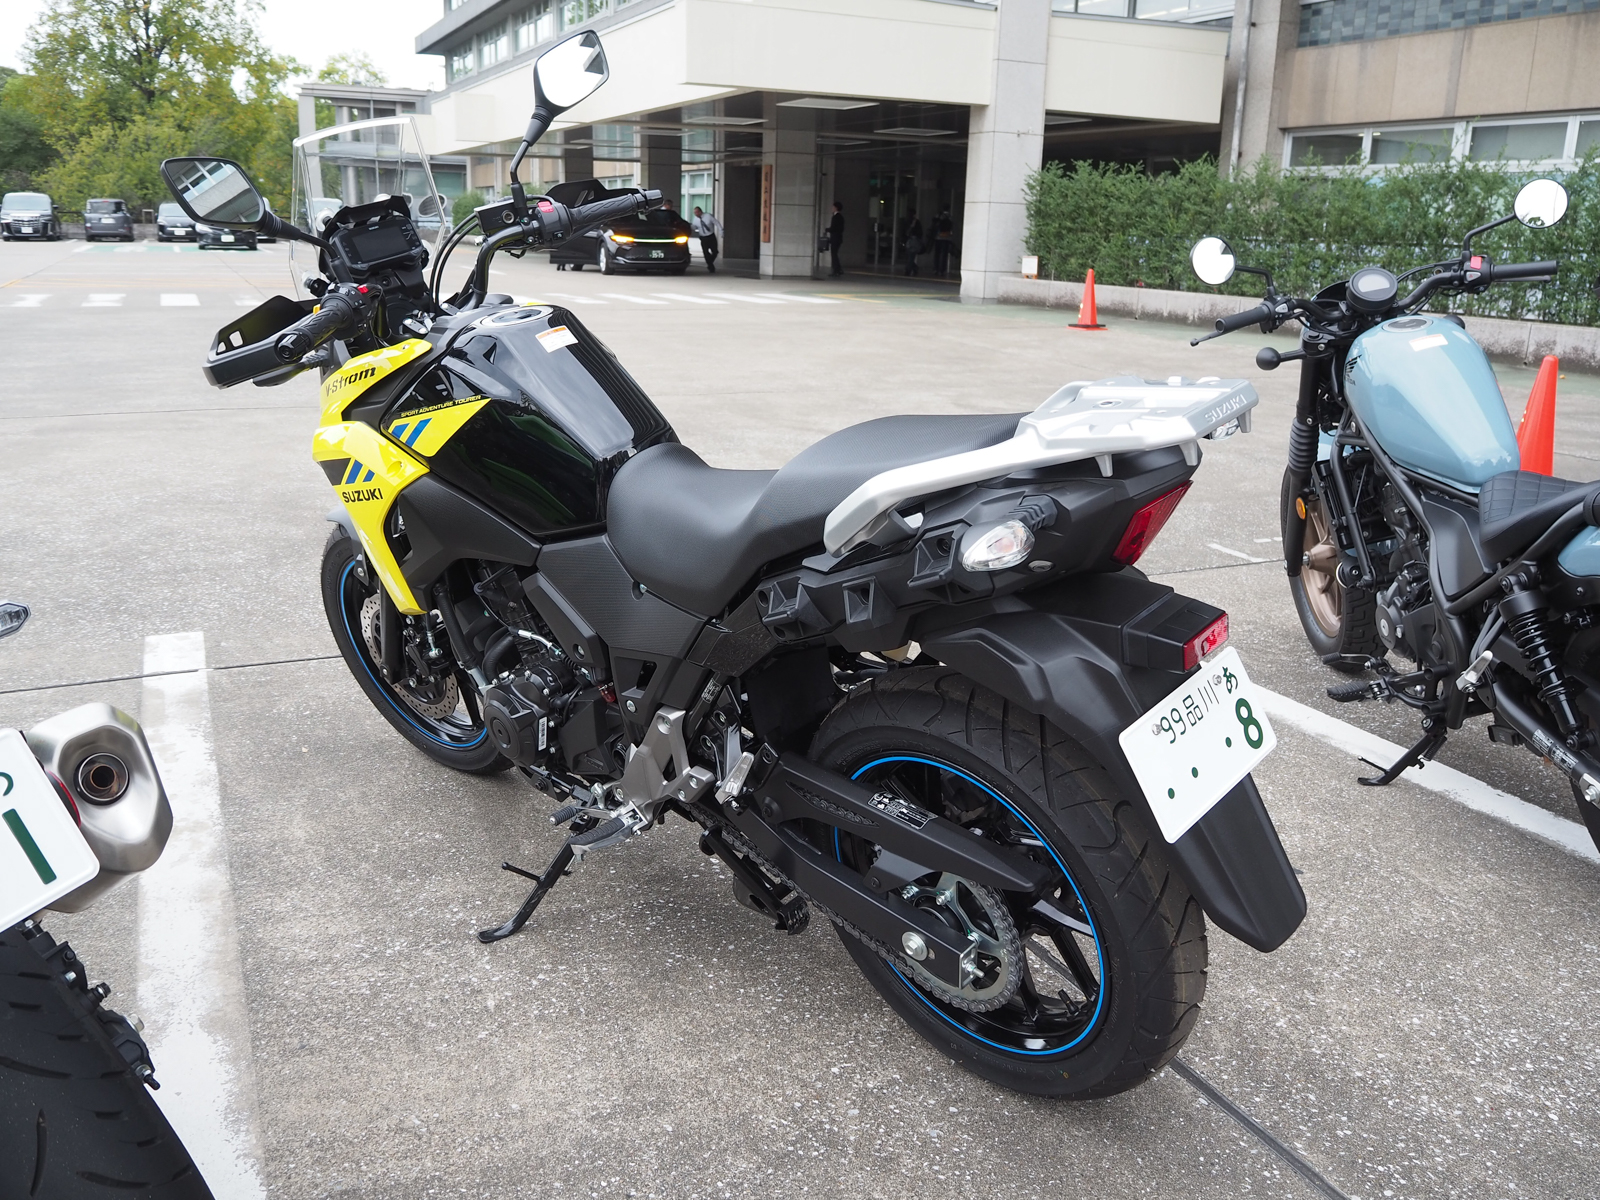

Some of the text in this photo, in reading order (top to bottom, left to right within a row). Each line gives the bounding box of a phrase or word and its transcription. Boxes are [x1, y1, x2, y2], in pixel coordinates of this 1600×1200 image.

[325, 366, 376, 397] V-Strom
[400, 394, 482, 418] SPORT ADVENTURE TOURER
[1205, 394, 1247, 424] SUZUKI
[342, 488, 383, 503] SUZUKI
